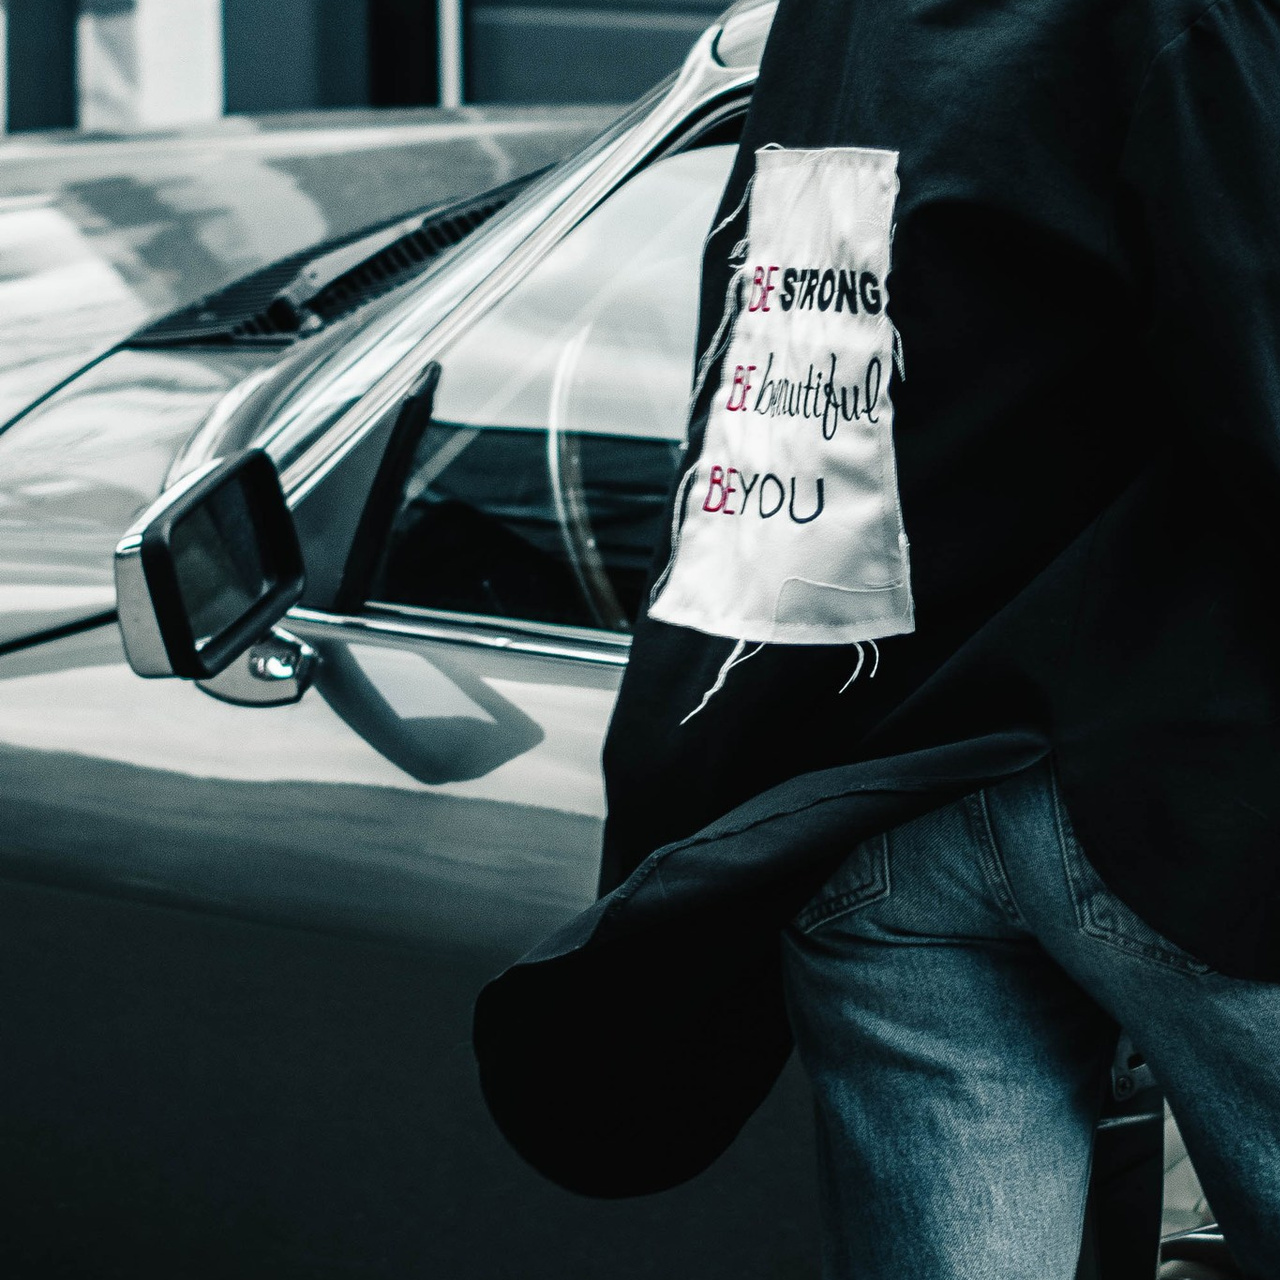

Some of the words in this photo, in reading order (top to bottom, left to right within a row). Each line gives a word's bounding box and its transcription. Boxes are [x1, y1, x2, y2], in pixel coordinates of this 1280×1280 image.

[749, 266, 779, 312] BE
[779, 267, 882, 315] STRONG
[726, 365, 757, 411] BE
[702, 465, 737, 514] BE
[738, 472, 825, 524] YOU
